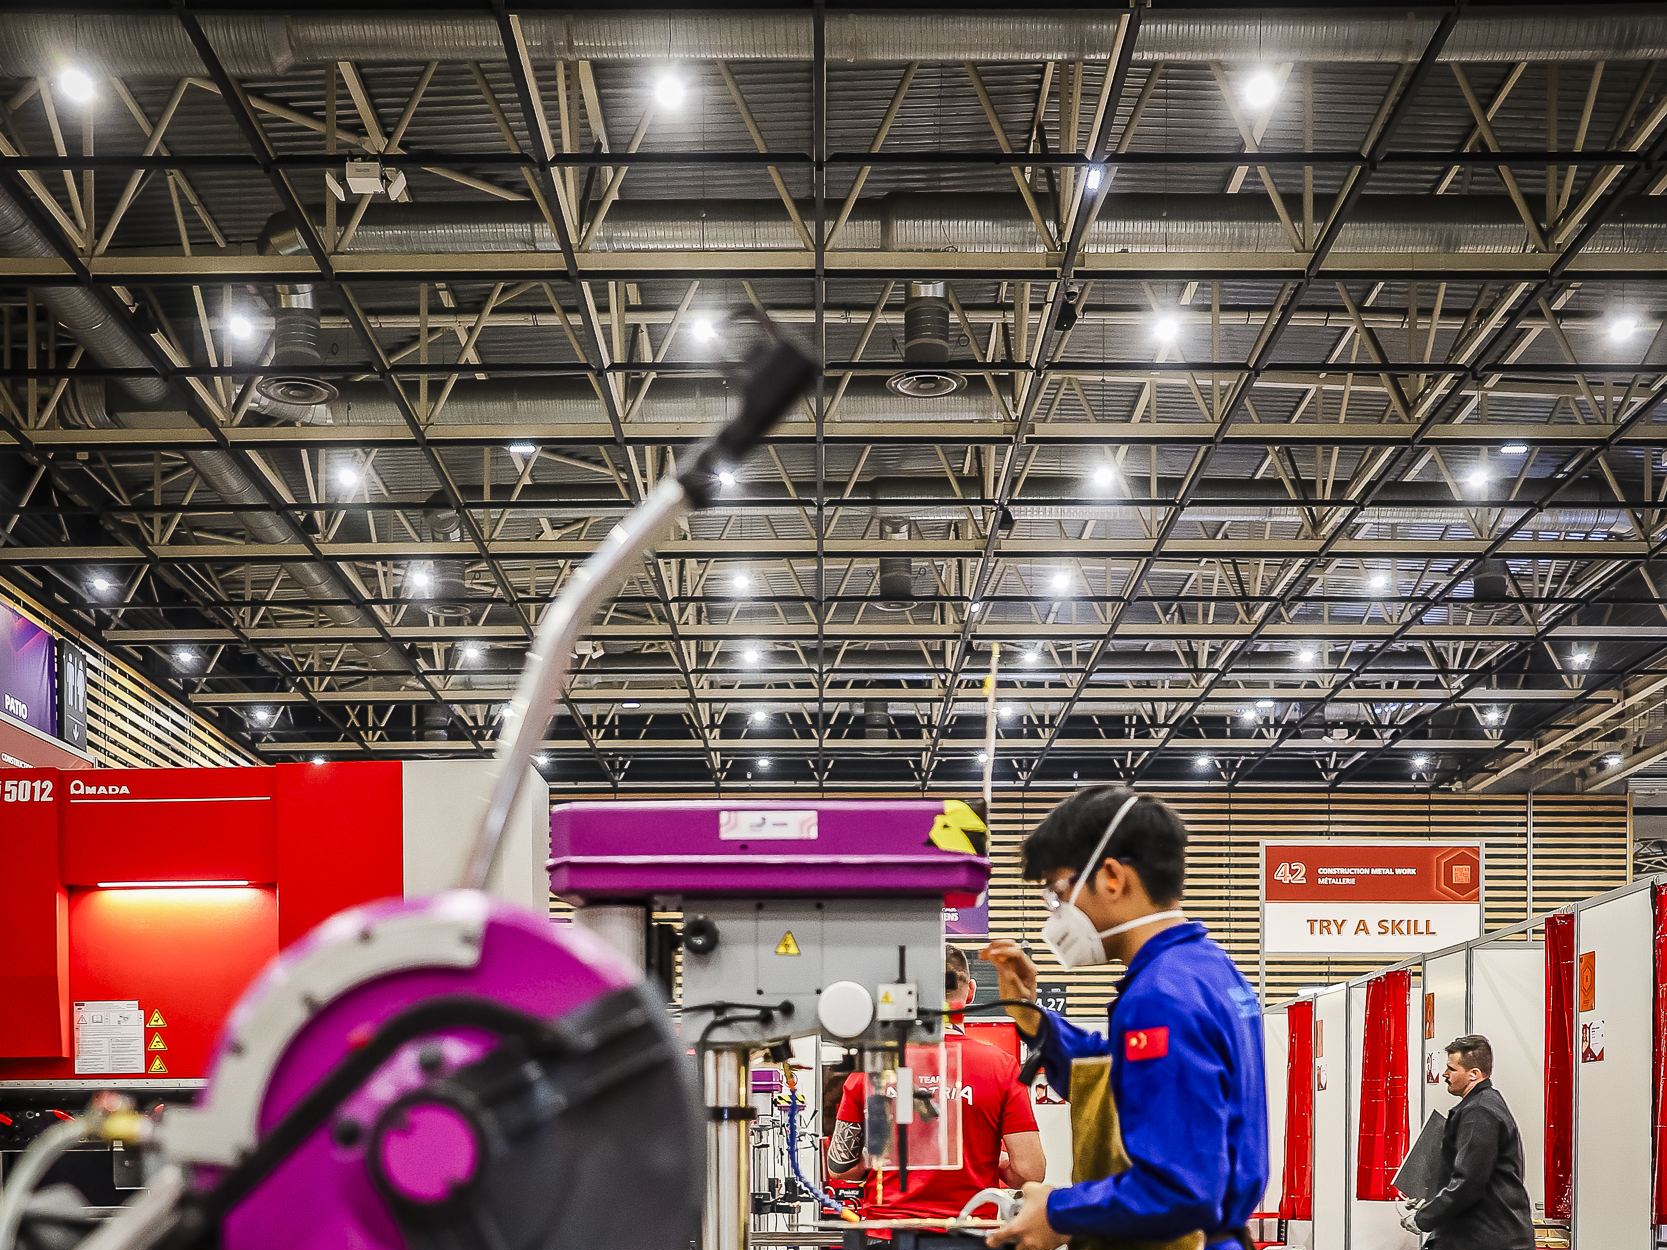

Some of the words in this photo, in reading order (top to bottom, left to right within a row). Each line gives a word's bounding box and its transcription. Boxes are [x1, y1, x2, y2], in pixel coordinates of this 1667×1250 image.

[4, 692, 28, 720] PATIO
[4, 779, 54, 802] 5012
[1274, 862, 1307, 884] 42
[1317, 867, 1370, 875] CONSTRUCTION
[1370, 867, 1394, 875] METAL
[1394, 867, 1417, 875] WORK
[1317, 876, 1356, 885] MÉTALLERIE
[1307, 919, 1347, 935] TRY
[1354, 919, 1370, 935] A
[1378, 919, 1437, 935] SKILL
[886, 1085, 974, 1106] ATRIA
